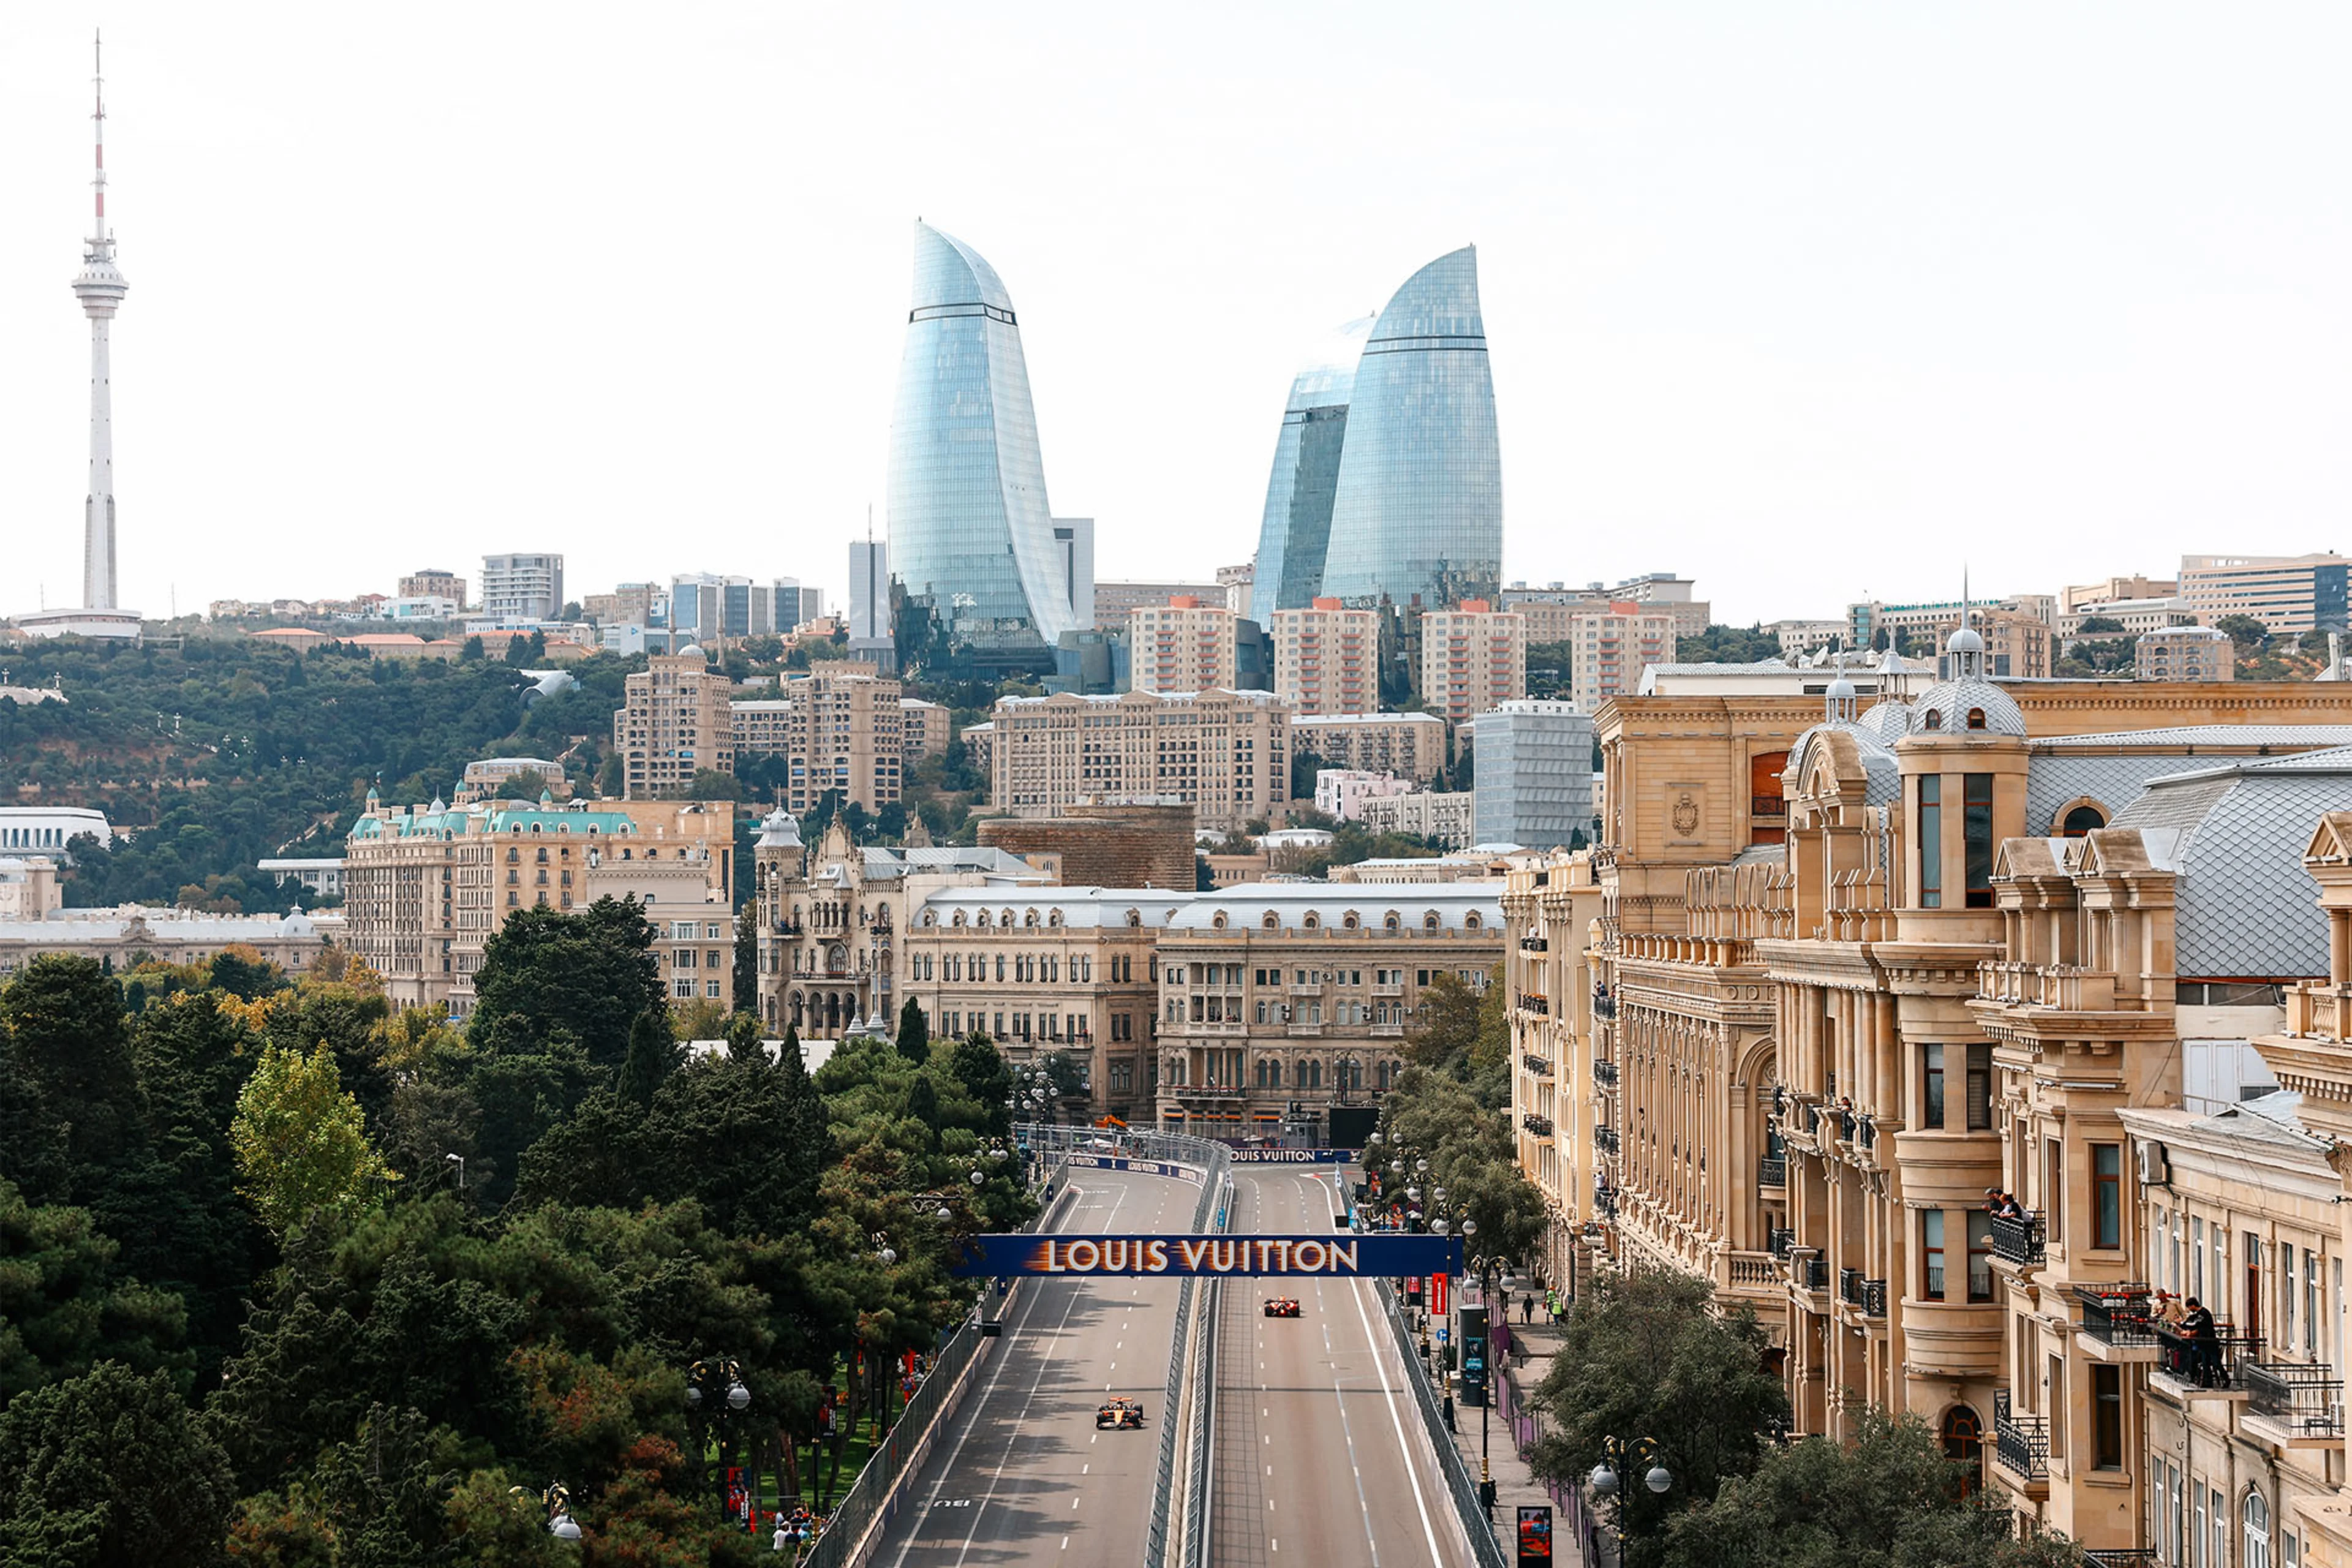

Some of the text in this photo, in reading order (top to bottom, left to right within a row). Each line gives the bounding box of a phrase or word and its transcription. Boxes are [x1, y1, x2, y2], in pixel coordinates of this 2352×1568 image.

[1230, 1151, 1315, 1161] OUIS VUITTON
[1049, 1240, 1357, 1272] LOUIS VUITTON
